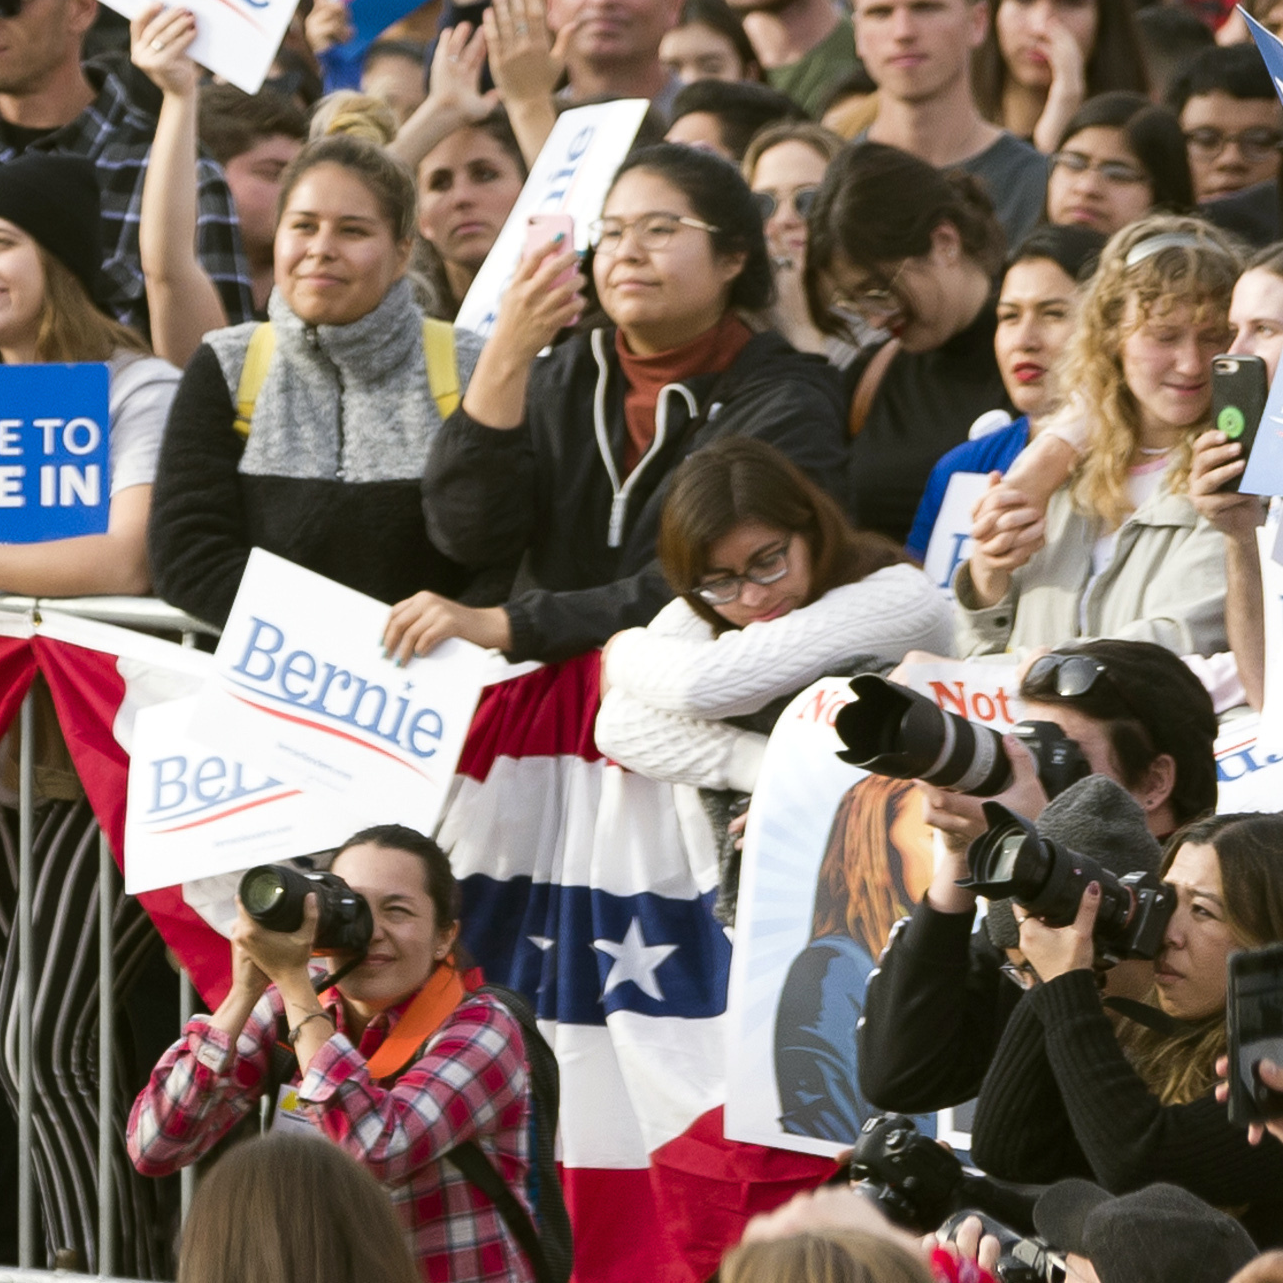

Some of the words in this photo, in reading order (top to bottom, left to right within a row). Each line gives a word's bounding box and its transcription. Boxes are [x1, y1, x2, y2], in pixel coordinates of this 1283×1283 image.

[33, 417, 101, 456] TO
[39, 464, 101, 508] IN
[231, 616, 444, 758] Bernie
[797, 689, 847, 727] No
[928, 681, 1015, 724] Not
